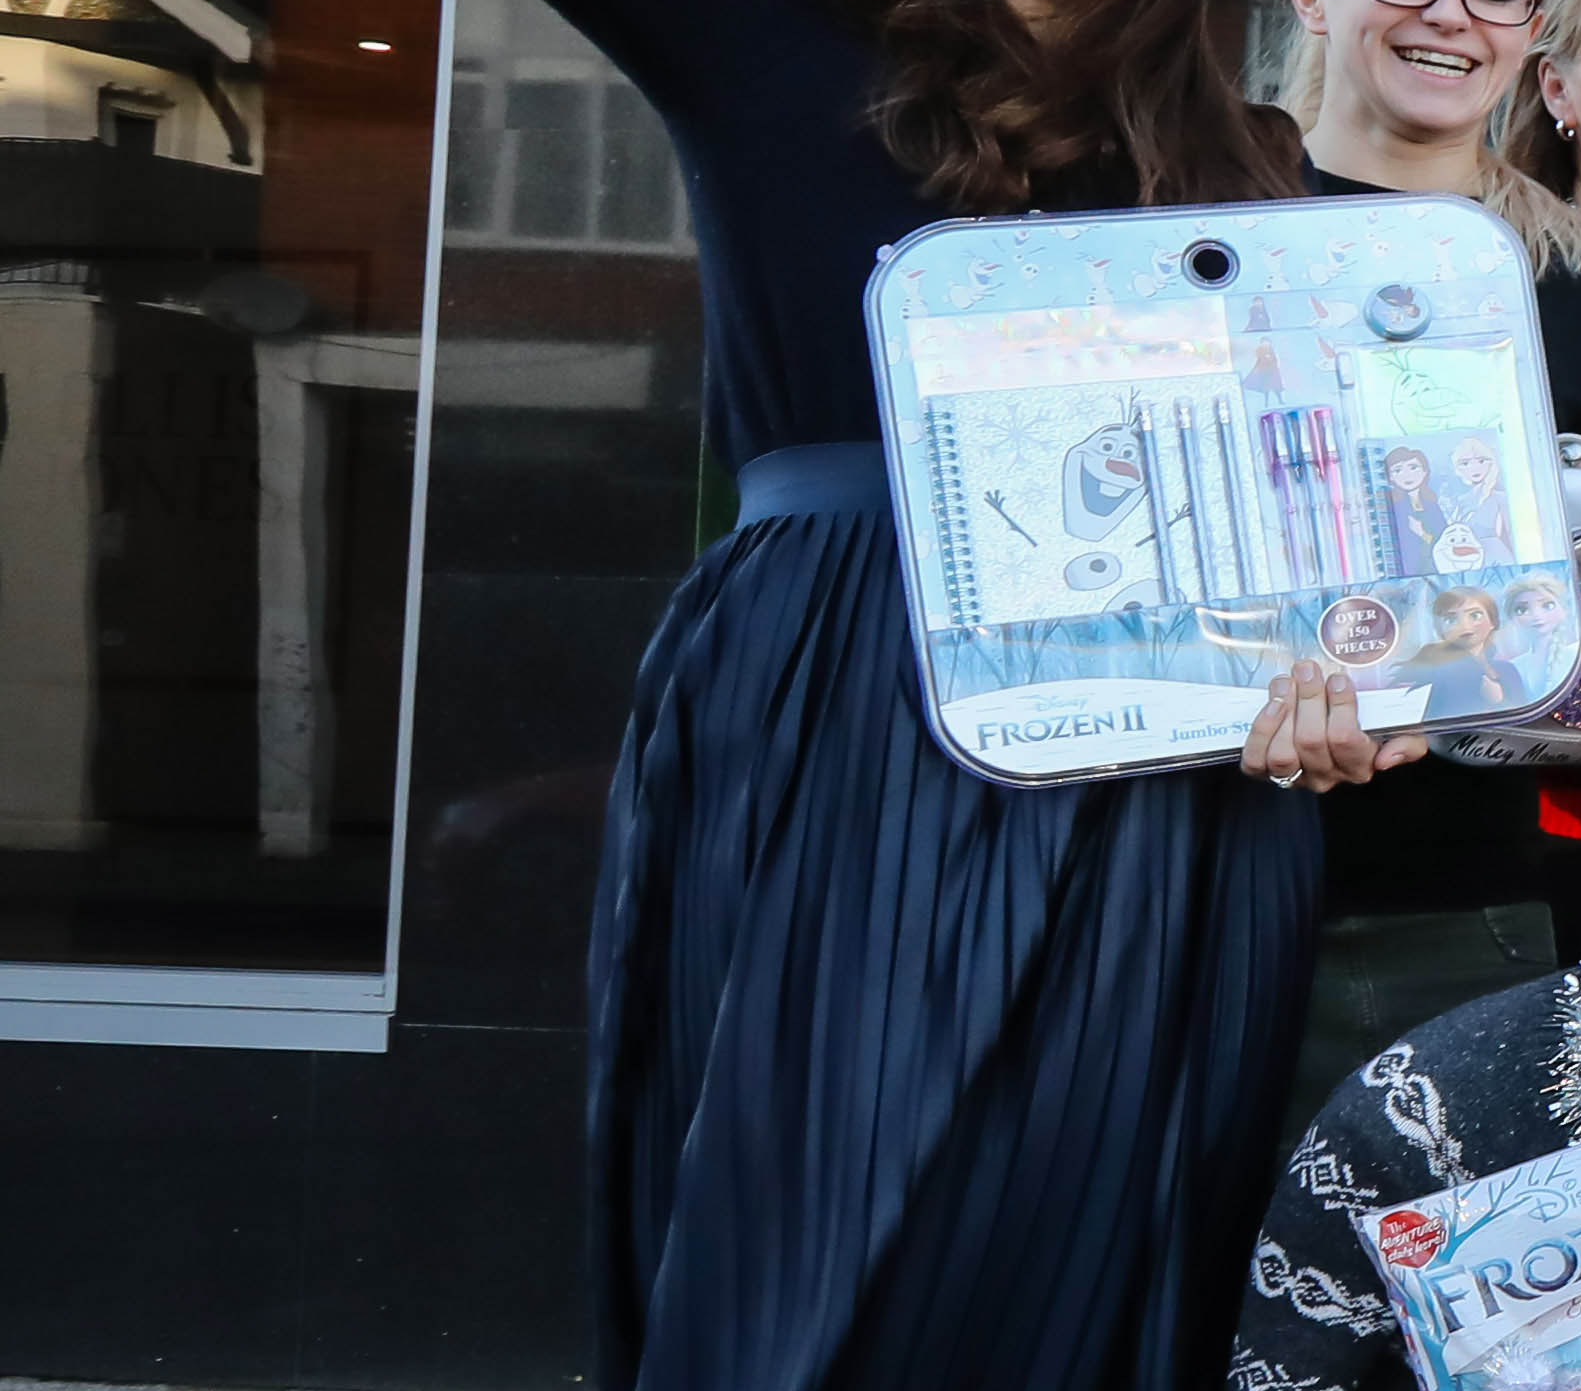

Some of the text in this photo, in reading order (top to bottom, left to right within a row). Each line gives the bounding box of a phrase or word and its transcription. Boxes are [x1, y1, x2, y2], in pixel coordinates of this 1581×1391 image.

[1335, 609, 1377, 624] OVER
[1348, 625, 1370, 638] 150
[1335, 639, 1387, 655] PIECES
[976, 703, 1148, 753] FROZEN II
[1169, 722, 1228, 743] Jumbo
[1449, 734, 1513, 764] Mickey
[1386, 1221, 1407, 1234] The
